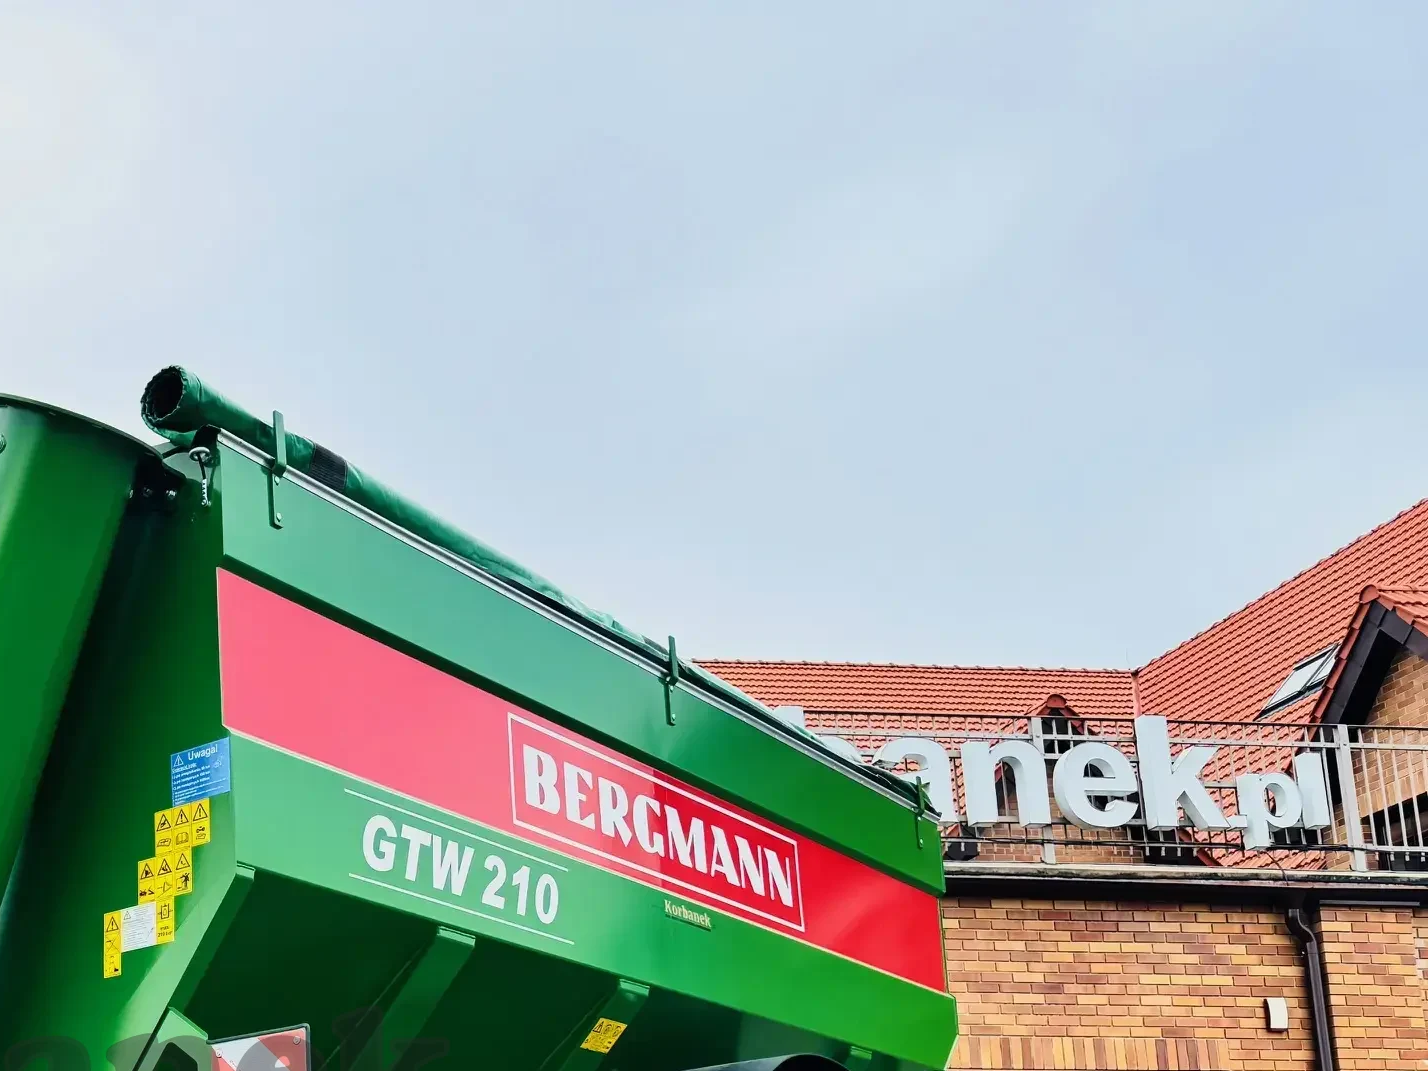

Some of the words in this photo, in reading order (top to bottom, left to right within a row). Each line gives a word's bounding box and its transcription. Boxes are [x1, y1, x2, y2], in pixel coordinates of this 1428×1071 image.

[522, 743, 794, 908] BERGMANN
[775, 706, 1331, 850] anek.pl
[362, 814, 475, 897] GTW
[481, 854, 559, 925] 210
[664, 899, 711, 928] Korbanek
